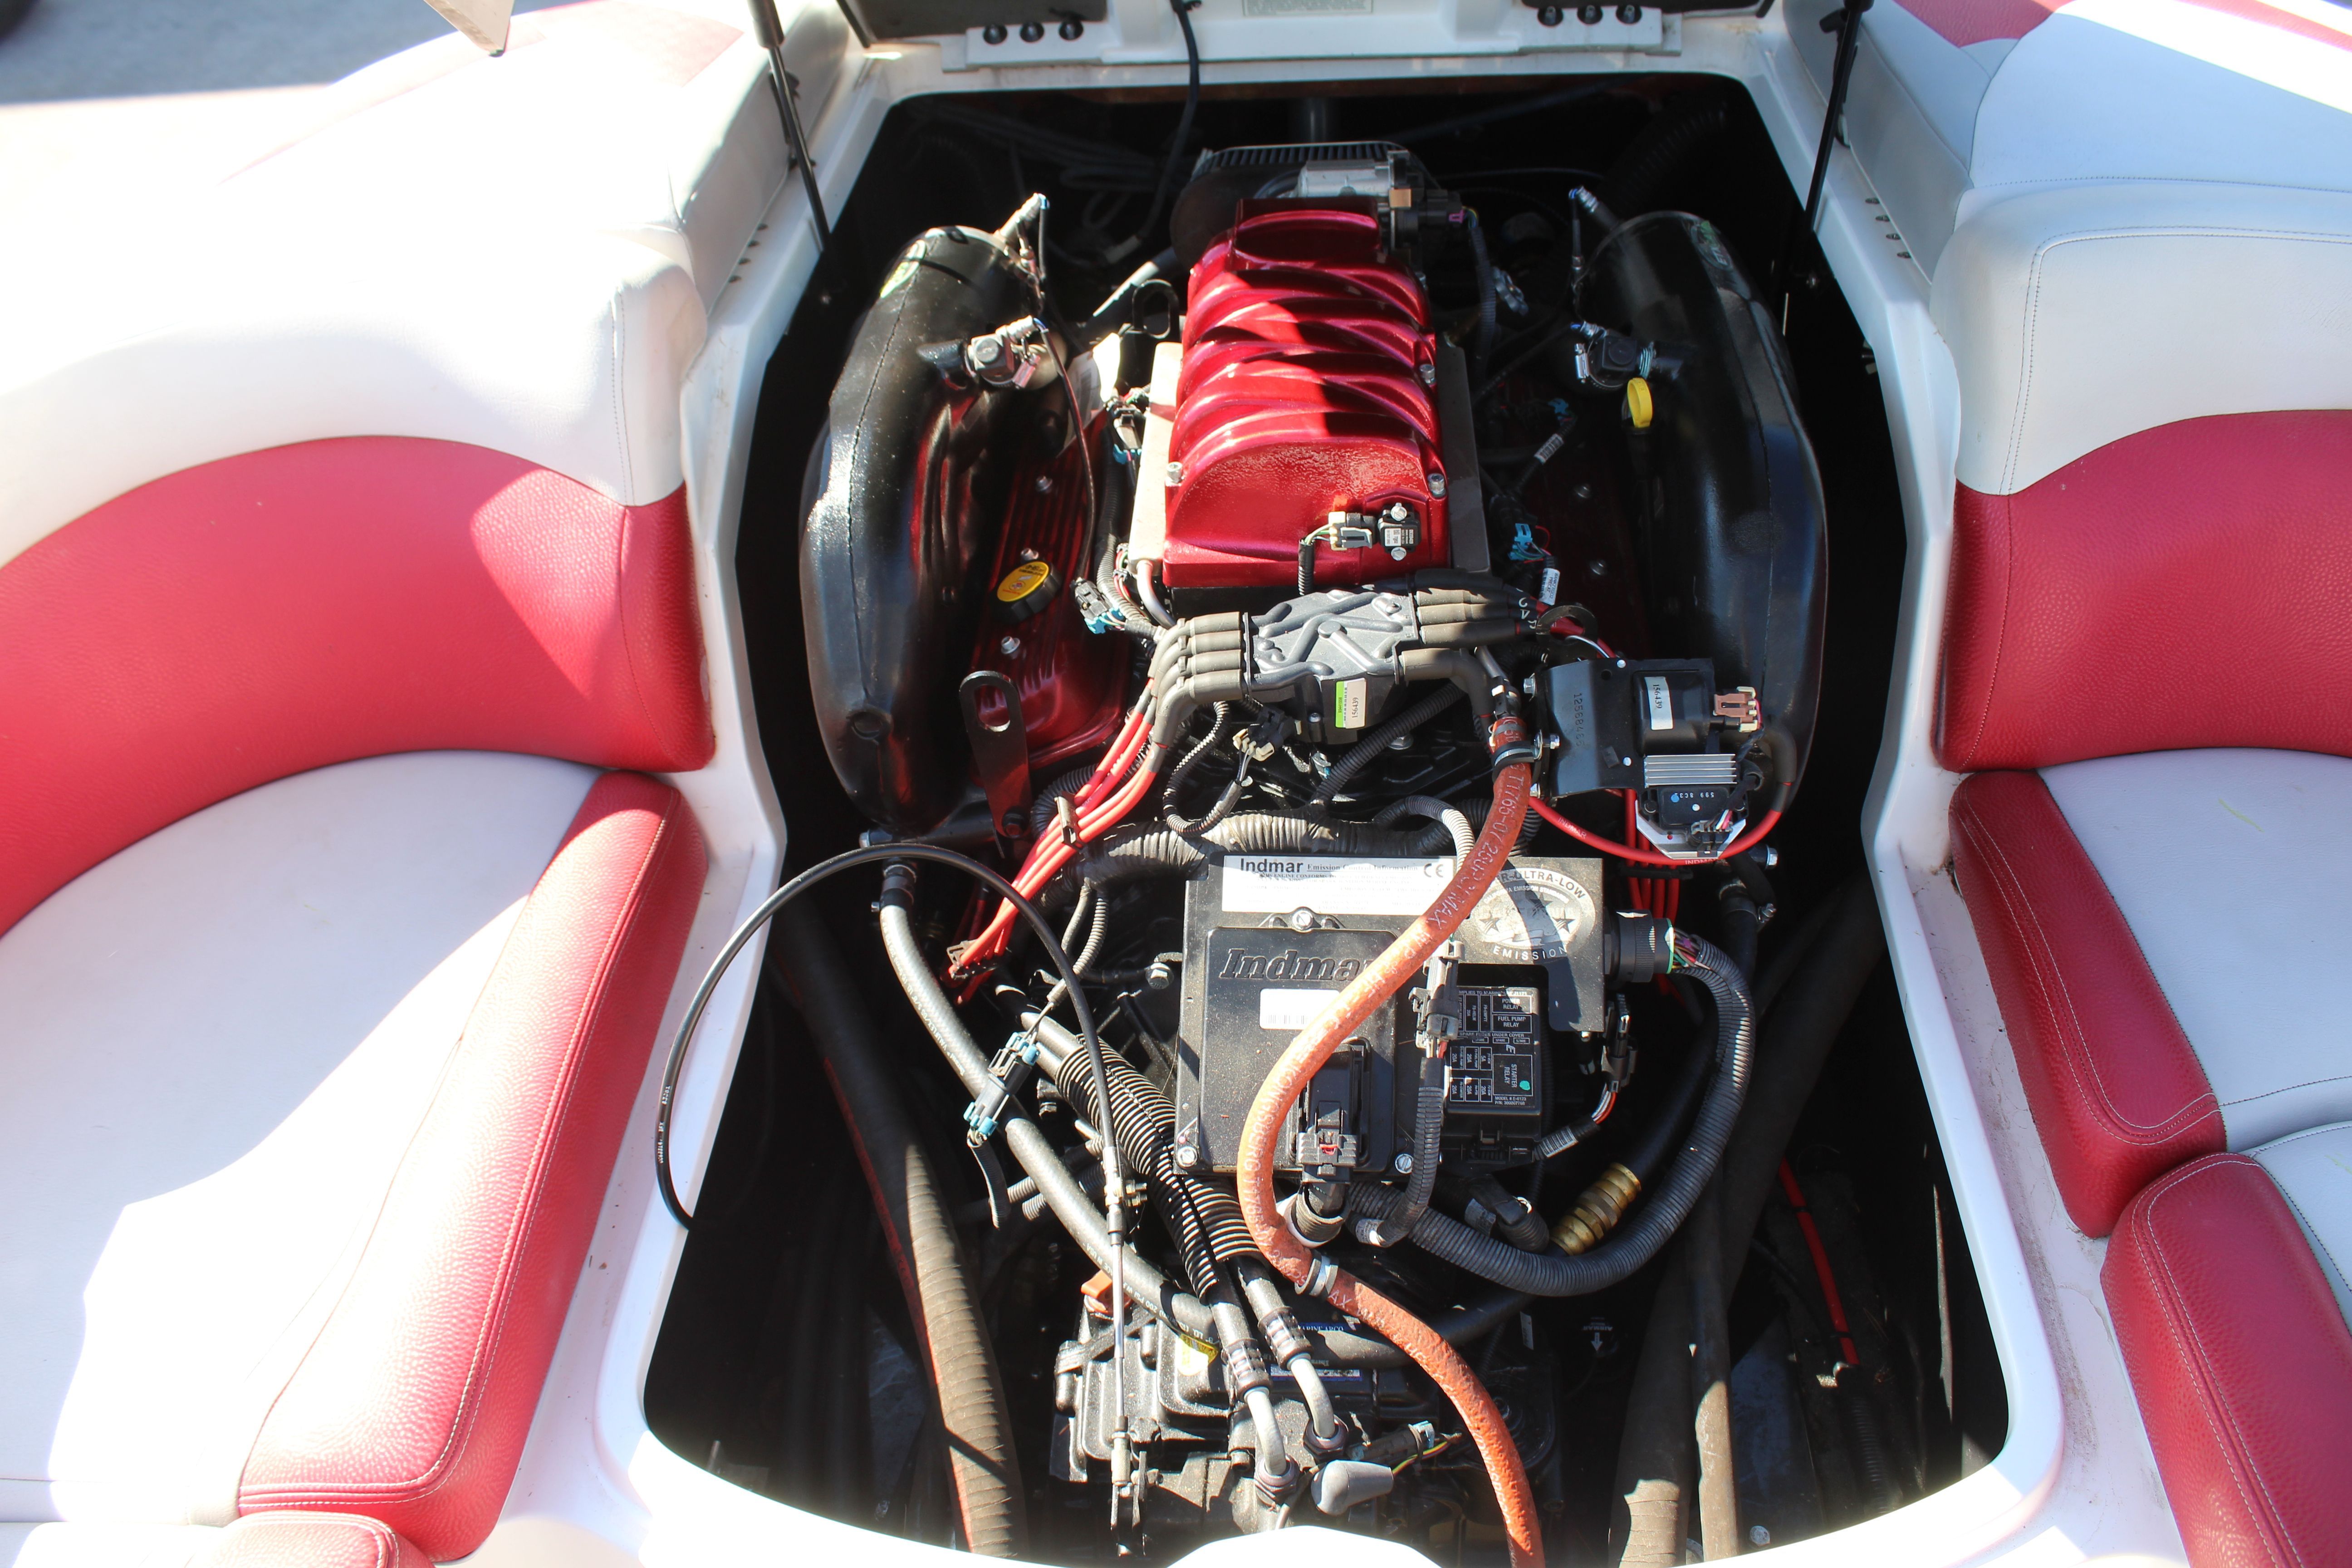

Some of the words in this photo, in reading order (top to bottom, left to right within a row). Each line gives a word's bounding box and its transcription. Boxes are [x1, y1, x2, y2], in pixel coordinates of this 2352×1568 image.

[1653, 684, 1662, 709] 156439
[1558, 817, 1587, 839] INDMAR
[1240, 858, 1303, 873] Indmar
[1501, 870, 1586, 899] R-ULTRA-LOW
[1493, 946, 1567, 960] EMISSION
